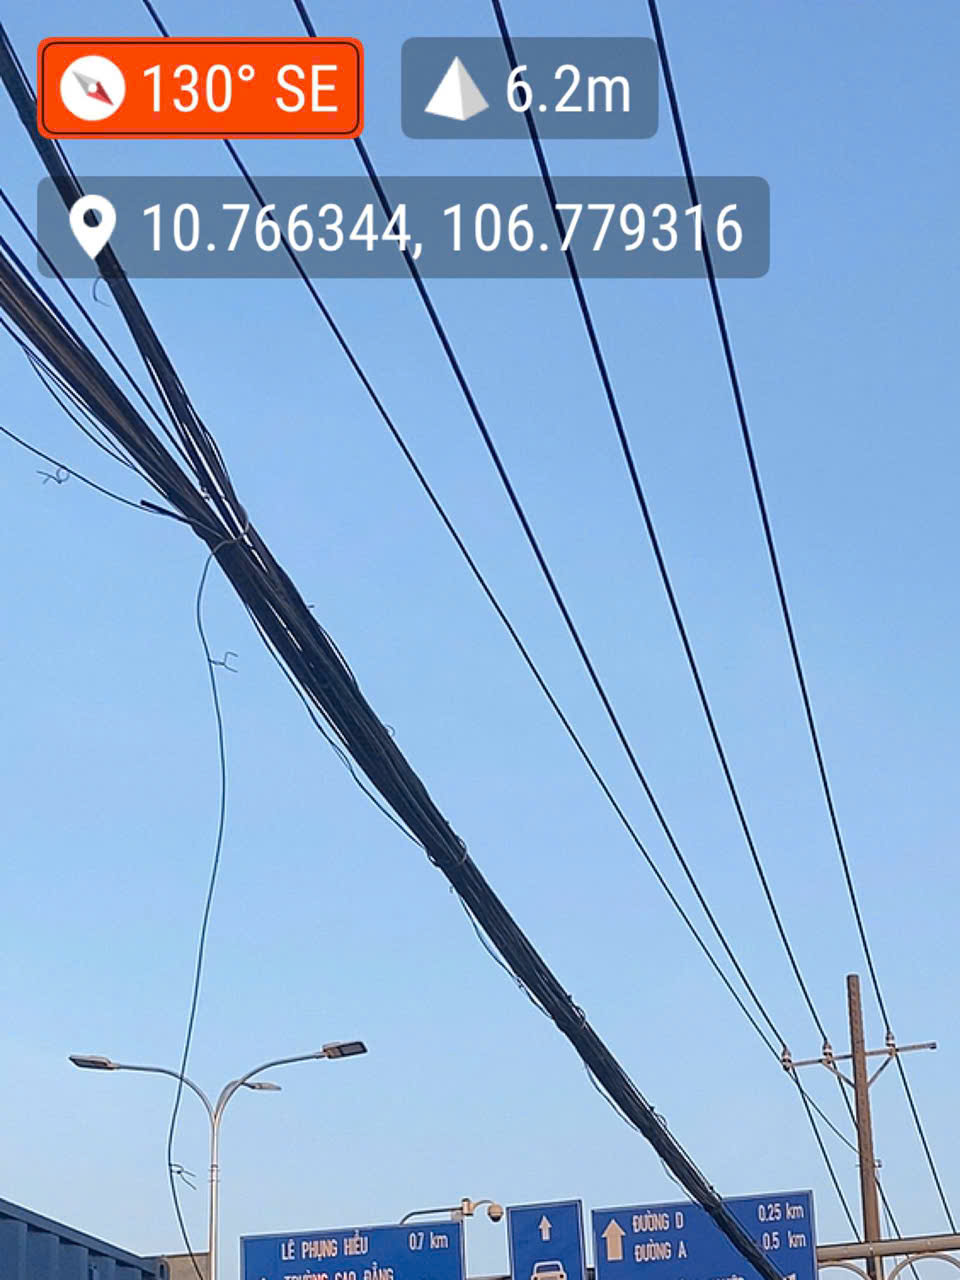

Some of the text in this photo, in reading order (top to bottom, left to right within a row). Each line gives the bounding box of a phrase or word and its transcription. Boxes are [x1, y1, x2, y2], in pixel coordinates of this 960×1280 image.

[632, 1209, 669, 1233] ĐƯỜNG
[758, 1203, 804, 1222] 0.25 km
[282, 1239, 295, 1261] LÊ
[302, 1239, 337, 1262] PHỤNG
[430, 1232, 449, 1249] km
[635, 1239, 687, 1262] ĐƯỜNG A
[762, 1231, 807, 1250] 0.5 km
